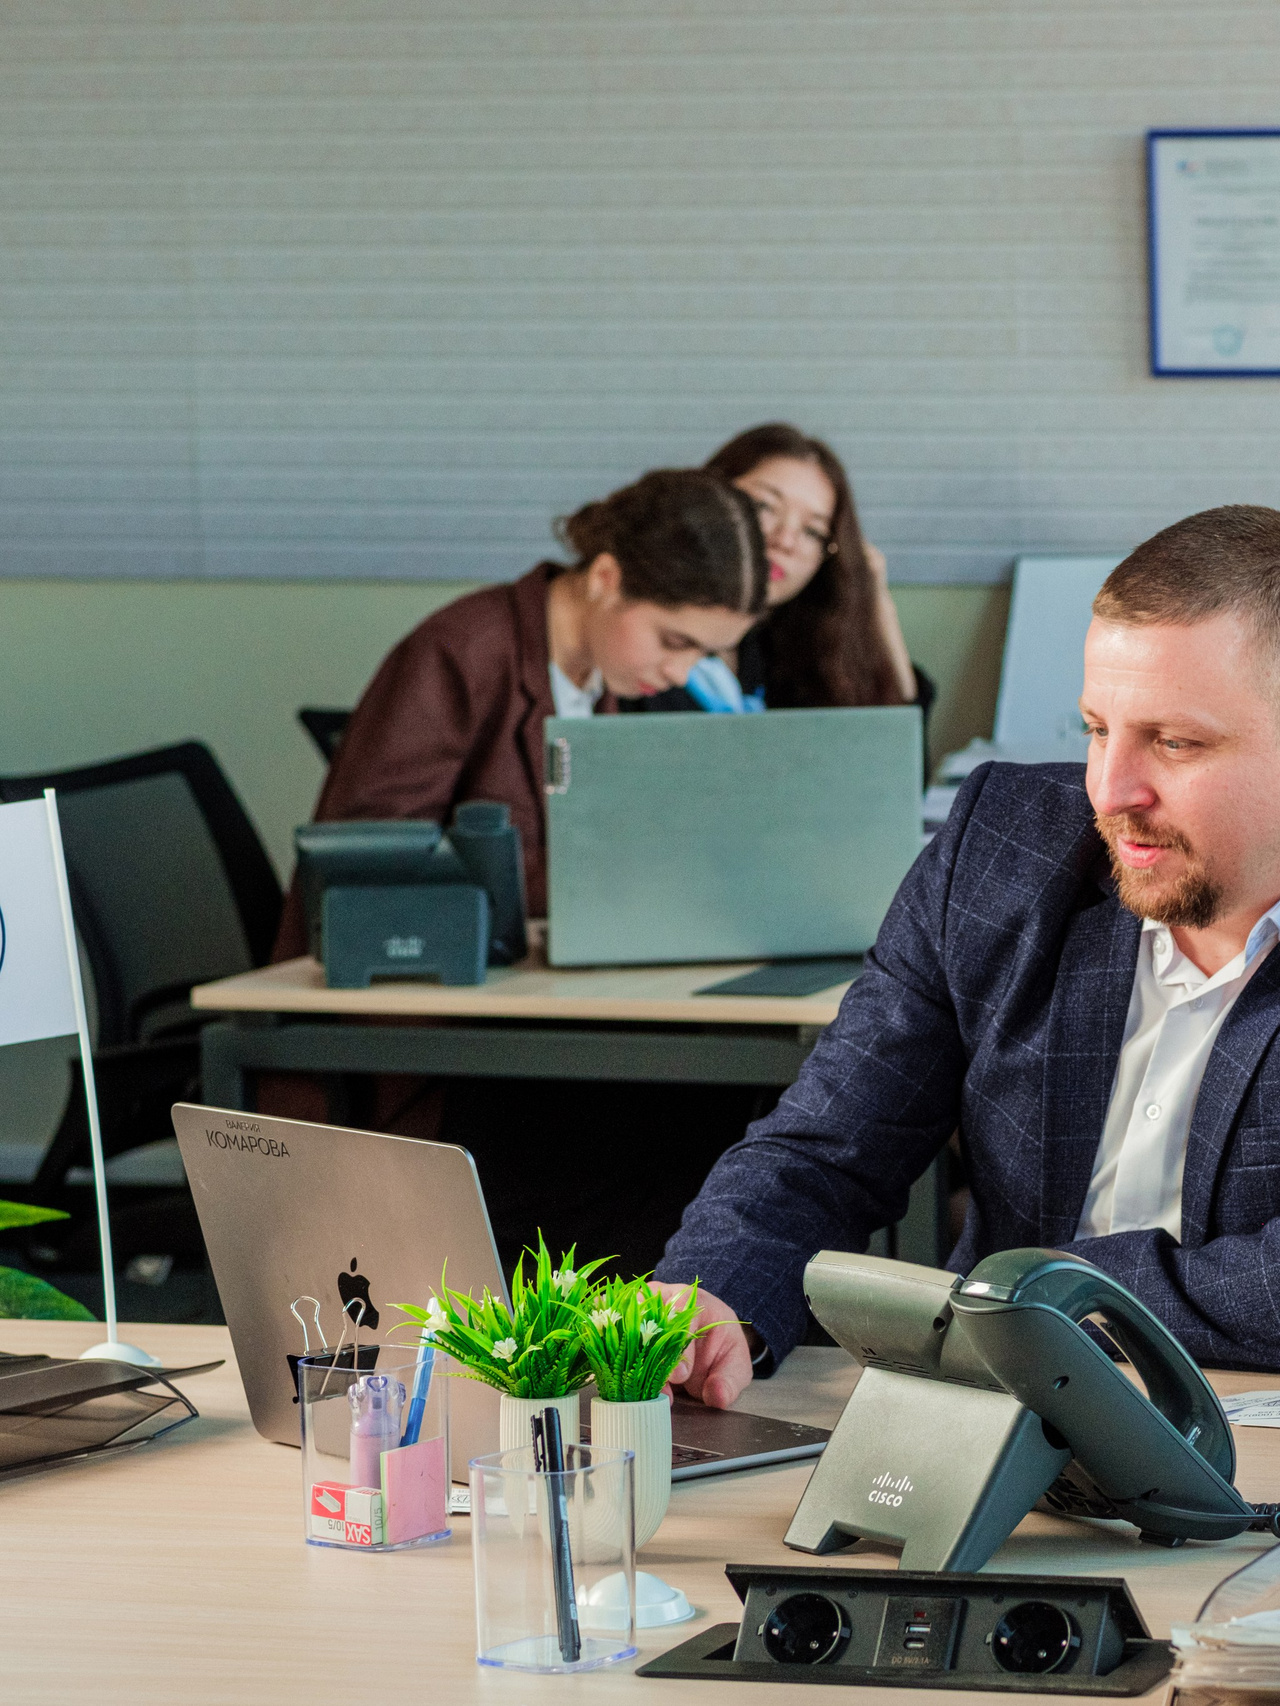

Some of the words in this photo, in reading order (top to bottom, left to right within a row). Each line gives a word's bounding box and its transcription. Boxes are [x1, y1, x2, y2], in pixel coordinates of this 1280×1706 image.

[205, 1129, 291, 1158] КОМАРОВА
[868, 1490, 903, 1507] CISCO
[327, 1519, 345, 1532] 10/5
[346, 1522, 371, 1544] SAX
